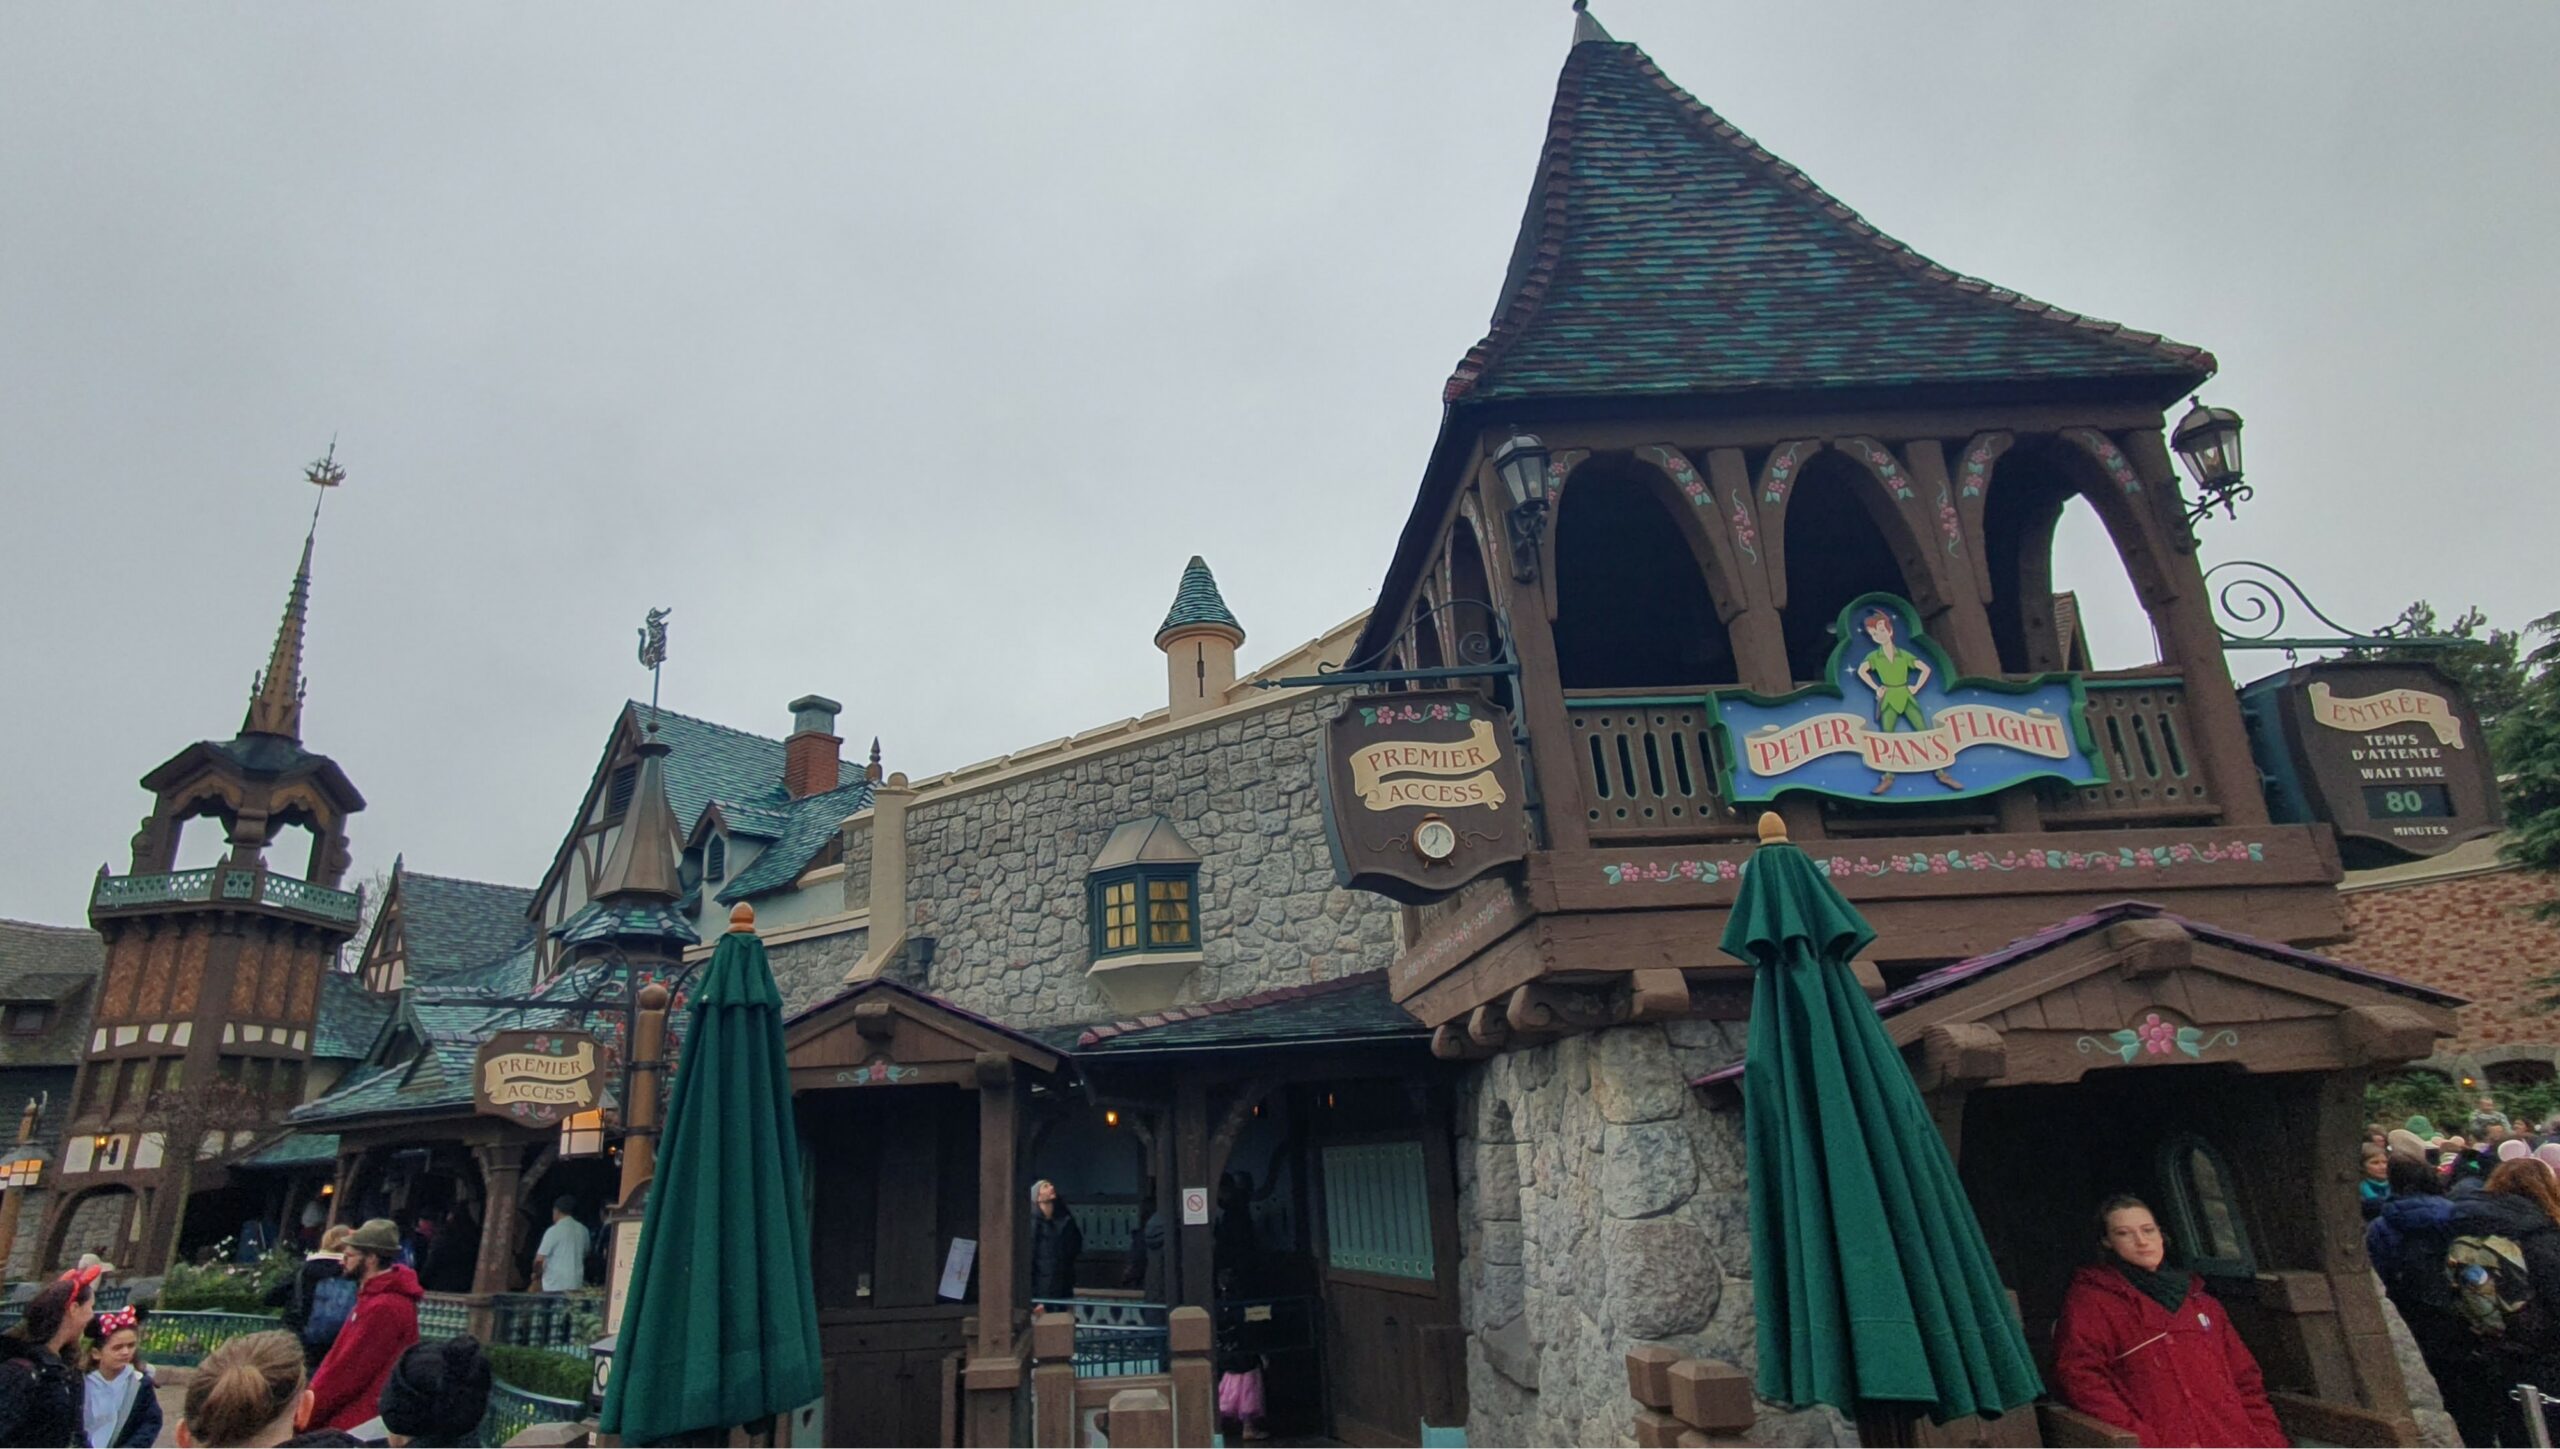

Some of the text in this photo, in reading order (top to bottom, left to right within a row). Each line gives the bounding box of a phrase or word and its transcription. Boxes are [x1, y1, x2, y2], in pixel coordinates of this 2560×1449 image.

[2331, 692, 2431, 723] ENTRÉE
[1753, 710, 2058, 770] PETER PAN'S FLIGHT
[2364, 734, 2419, 746] TEMPS
[1368, 746, 1486, 772] PREMIER
[2351, 748, 2441, 761] D'ATTENTE
[2360, 766, 2445, 780] WAIT TIME
[1389, 783, 1484, 803] ACCESS
[2385, 790, 2423, 813] 80
[2393, 826, 2449, 836] MINUTES
[498, 1058, 583, 1076] PREMIER
[507, 1084, 576, 1101] ACCESS
